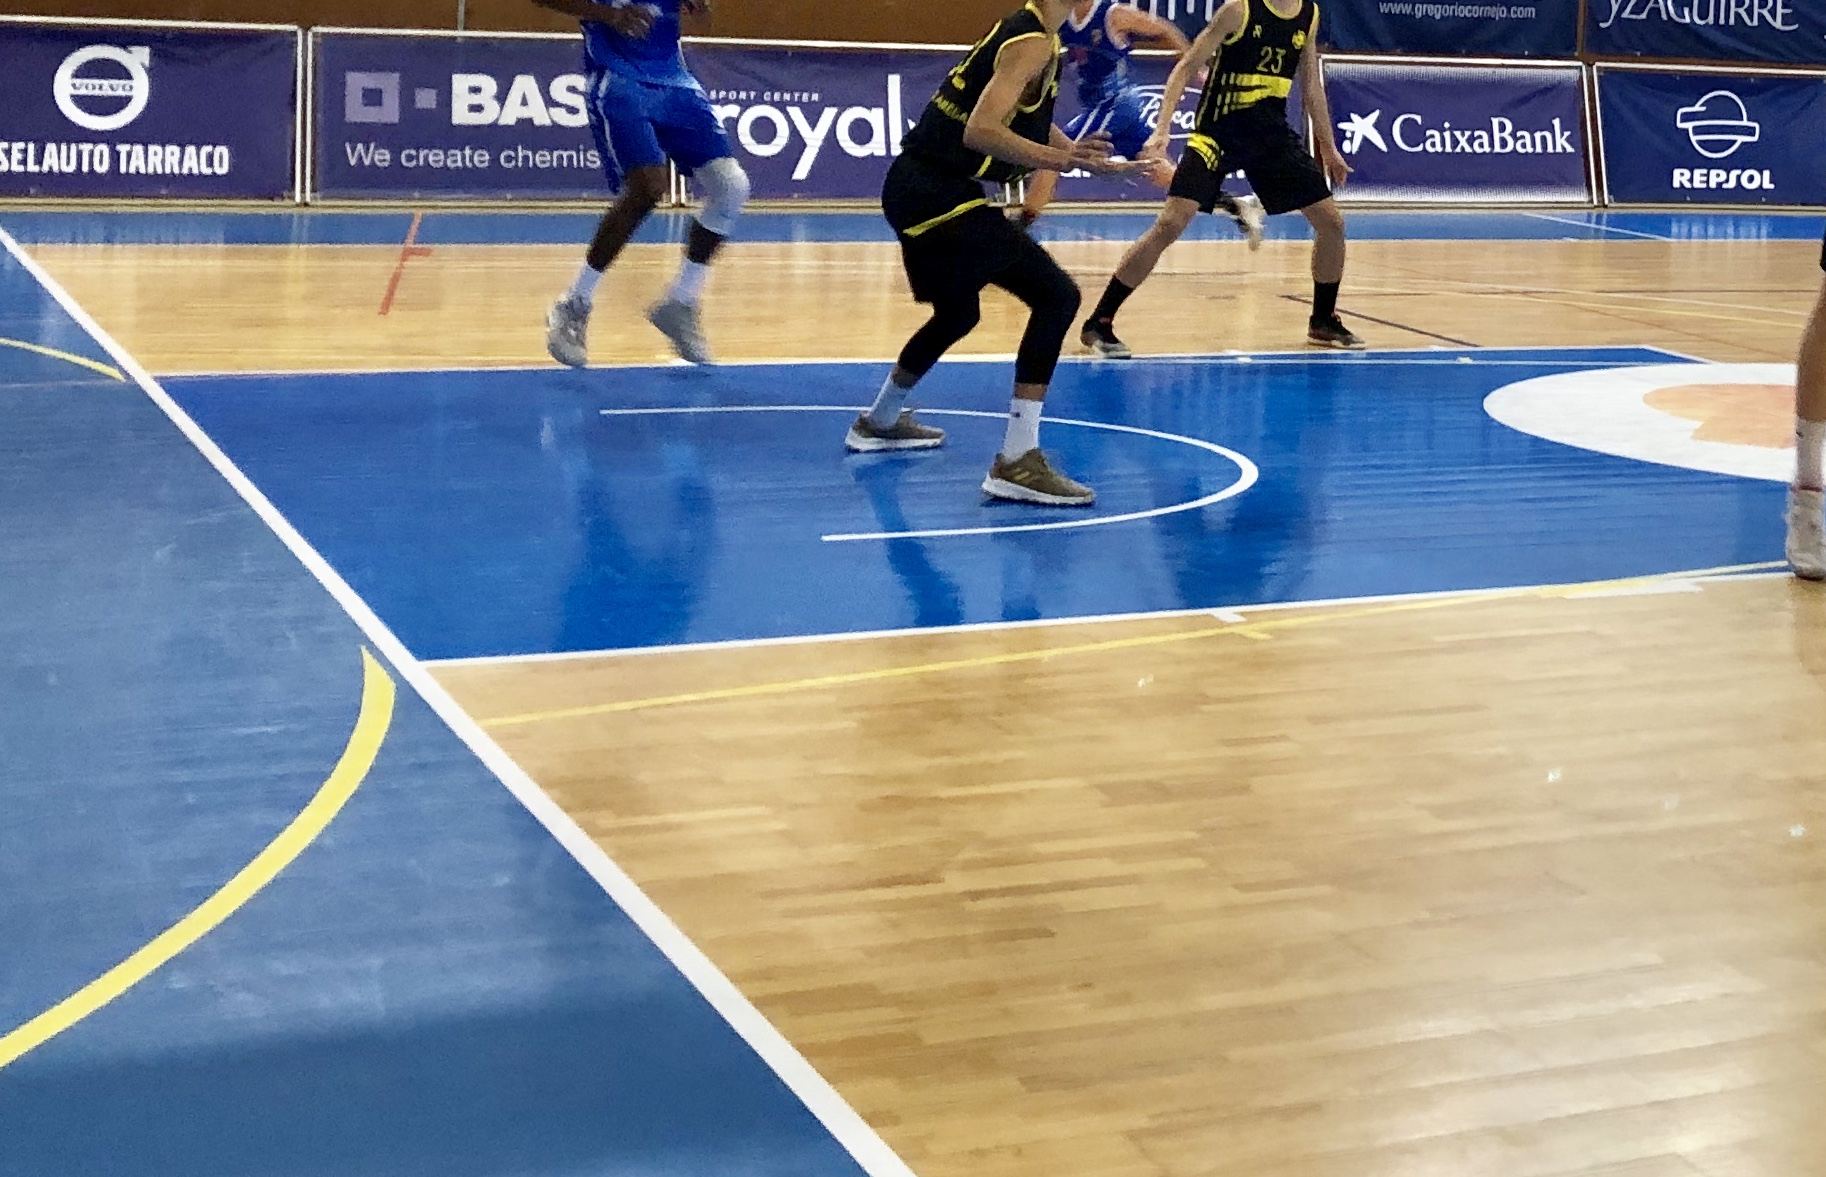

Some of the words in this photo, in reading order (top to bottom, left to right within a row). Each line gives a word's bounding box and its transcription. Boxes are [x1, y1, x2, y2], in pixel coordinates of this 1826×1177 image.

[1379, 1, 1536, 20] www.gregoriocornejo.com
[1256, 45, 1287, 74] 23
[71, 82, 134, 92] VOLVO
[451, 73, 590, 127] BAS
[709, 89, 756, 101] SPORT
[763, 91, 820, 103] CENTER
[711, 73, 904, 181] royal
[1391, 113, 1576, 154] CaixaBank
[116, 143, 230, 175] TARRACO
[345, 142, 390, 167] We
[400, 146, 490, 168] create
[499, 144, 601, 168] chemis
[1672, 168, 1775, 190] REPSOL
